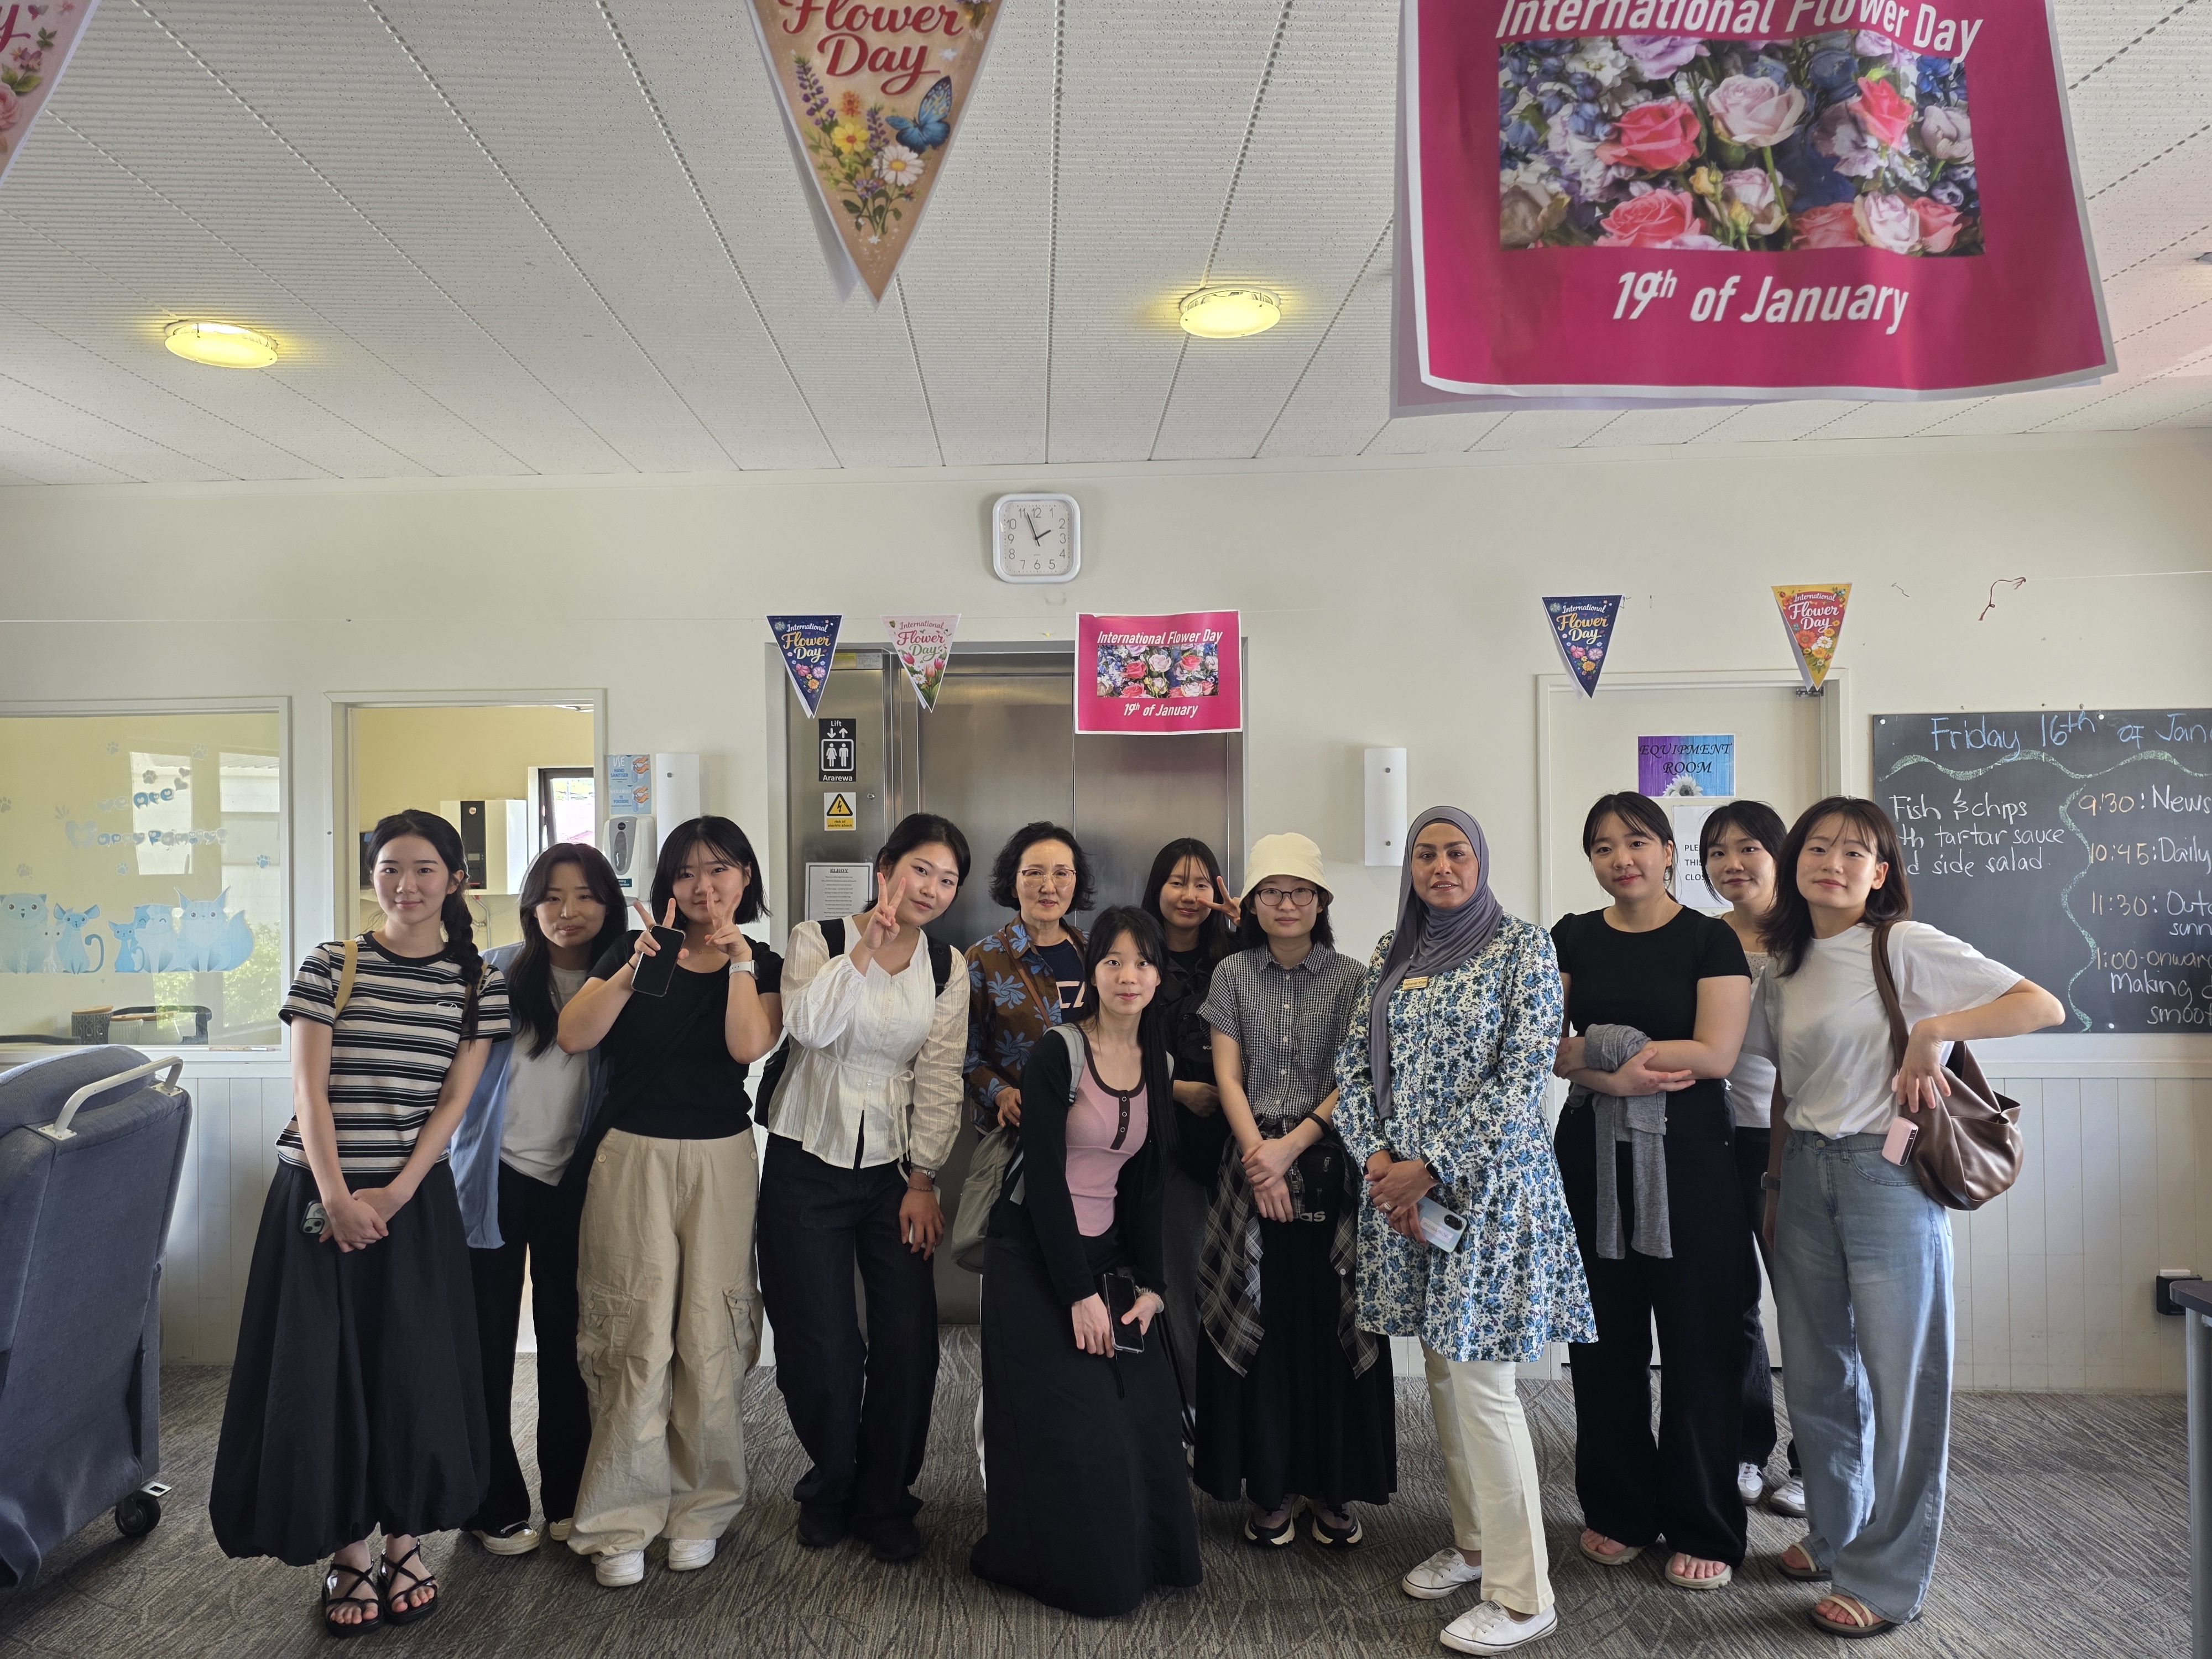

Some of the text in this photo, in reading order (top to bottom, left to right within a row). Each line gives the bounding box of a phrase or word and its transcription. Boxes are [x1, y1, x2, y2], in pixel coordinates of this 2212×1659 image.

[779, 0, 964, 36] Flower
[1495, 0, 1984, 64] International Flower Day
[817, 32, 941, 95] Day
[1613, 269, 1909, 335] 19th of January
[1019, 508, 1026, 518] 11
[1031, 508, 1042, 518] 12
[1050, 508, 1053, 518] 1
[1006, 519, 1016, 529] 10
[1058, 518, 1066, 529] 2
[1008, 534, 1014, 544] 9
[1060, 533, 1066, 544] 3
[1009, 549, 1015, 560] 8
[1059, 549, 1066, 559] 4
[1020, 560, 1026, 570] 7
[1034, 560, 1041, 570] 6
[1048, 559, 1056, 570] 5
[1793, 593, 1837, 602] International
[1562, 604, 1606, 614] International
[1788, 601, 1839, 620] Flower
[786, 623, 828, 632] International
[899, 620, 945, 630] International
[1556, 612, 1609, 631] Flower
[1800, 617, 1833, 633] Day
[781, 631, 831, 649] Flower
[896, 629, 946, 646] Flower
[1097, 629, 1223, 645] International Flower Day
[1568, 628, 1602, 645] Day
[793, 646, 825, 663] Day
[909, 644, 940, 661] Day
[1142, 704, 1156, 716] of
[1155, 704, 1199, 718] January
[1931, 710, 2212, 761] Friday 16th of Jan
[1639, 743, 1733, 759] EQUIPMENT
[613, 755, 625, 767] USE
[1662, 761, 1712, 776] ROOM
[2152, 784, 2212, 814] News
[1888, 794, 1941, 822] Fish
[2012, 828, 2065, 844] sauce
[1932, 848, 1975, 877] side
[2158, 835, 2212, 875] Daily
